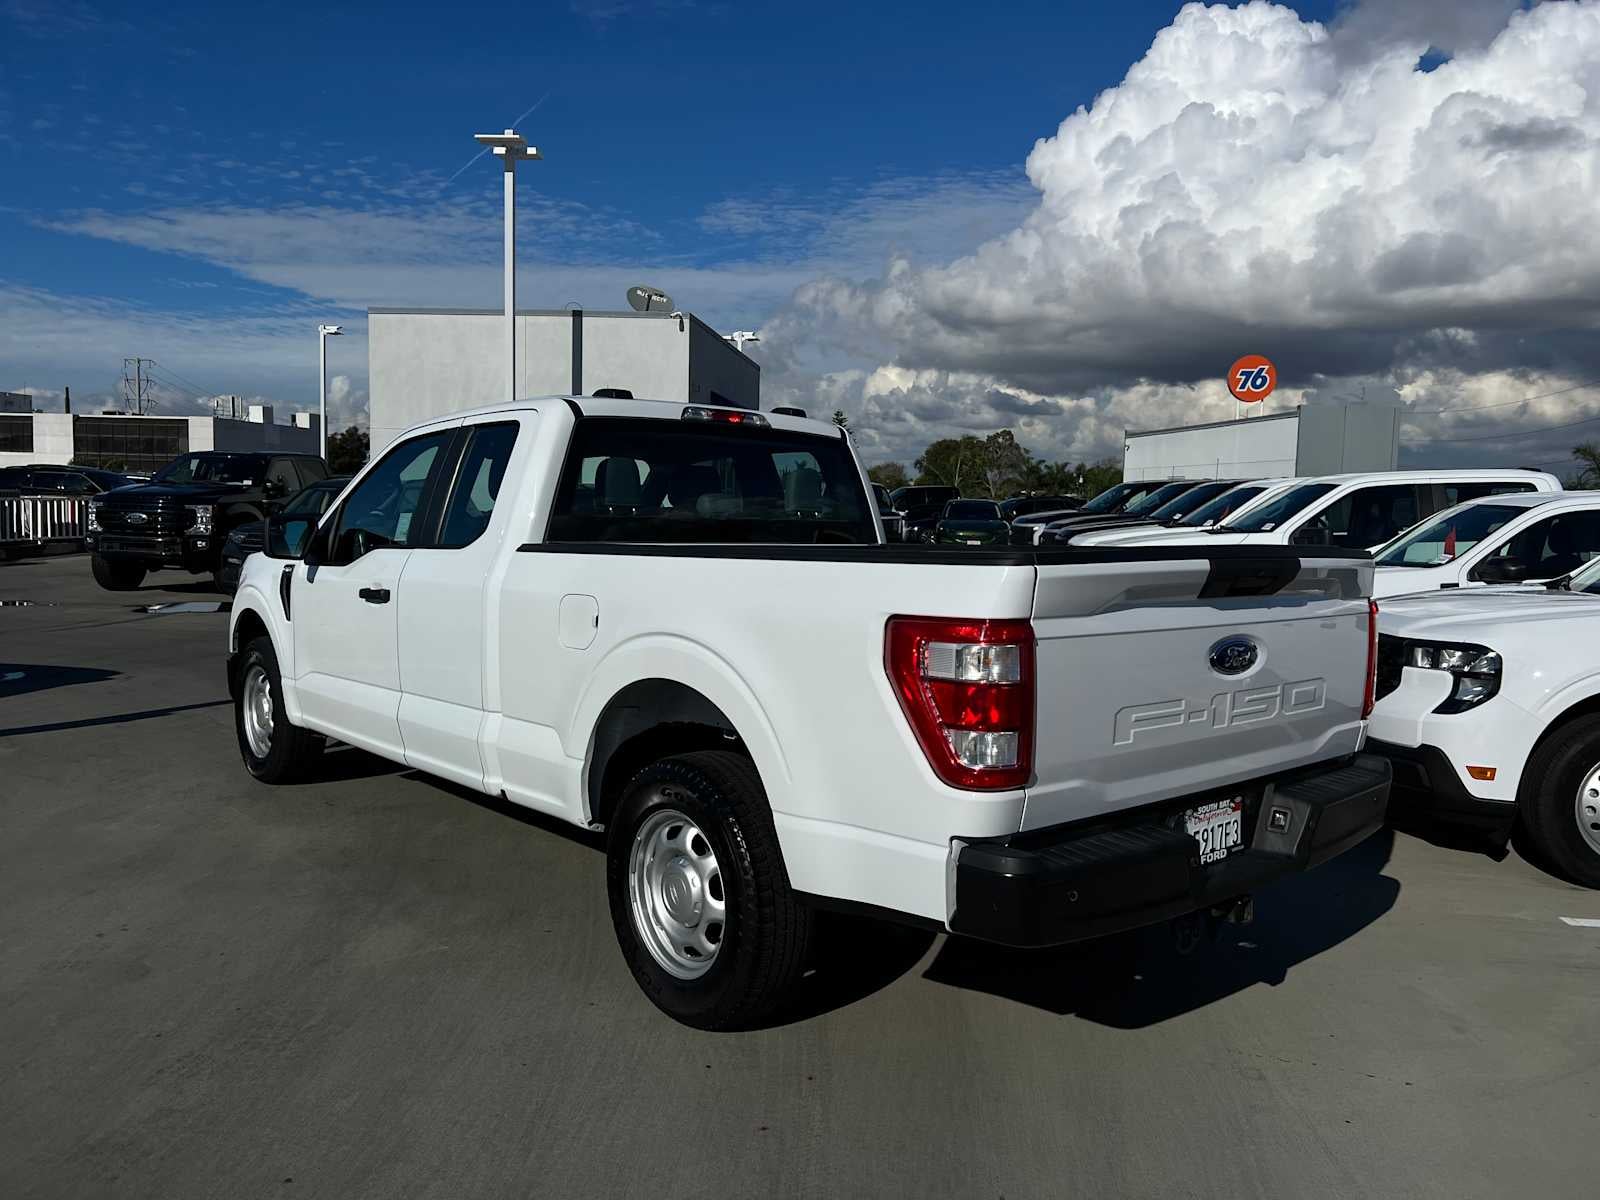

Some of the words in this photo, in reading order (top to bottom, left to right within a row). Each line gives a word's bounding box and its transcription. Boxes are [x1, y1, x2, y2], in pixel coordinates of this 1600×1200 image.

[1236, 365, 1270, 392] 76
[1112, 677, 1327, 746] F-150
[1197, 802, 1218, 815] SOUTH
[1200, 848, 1227, 865] FORD
